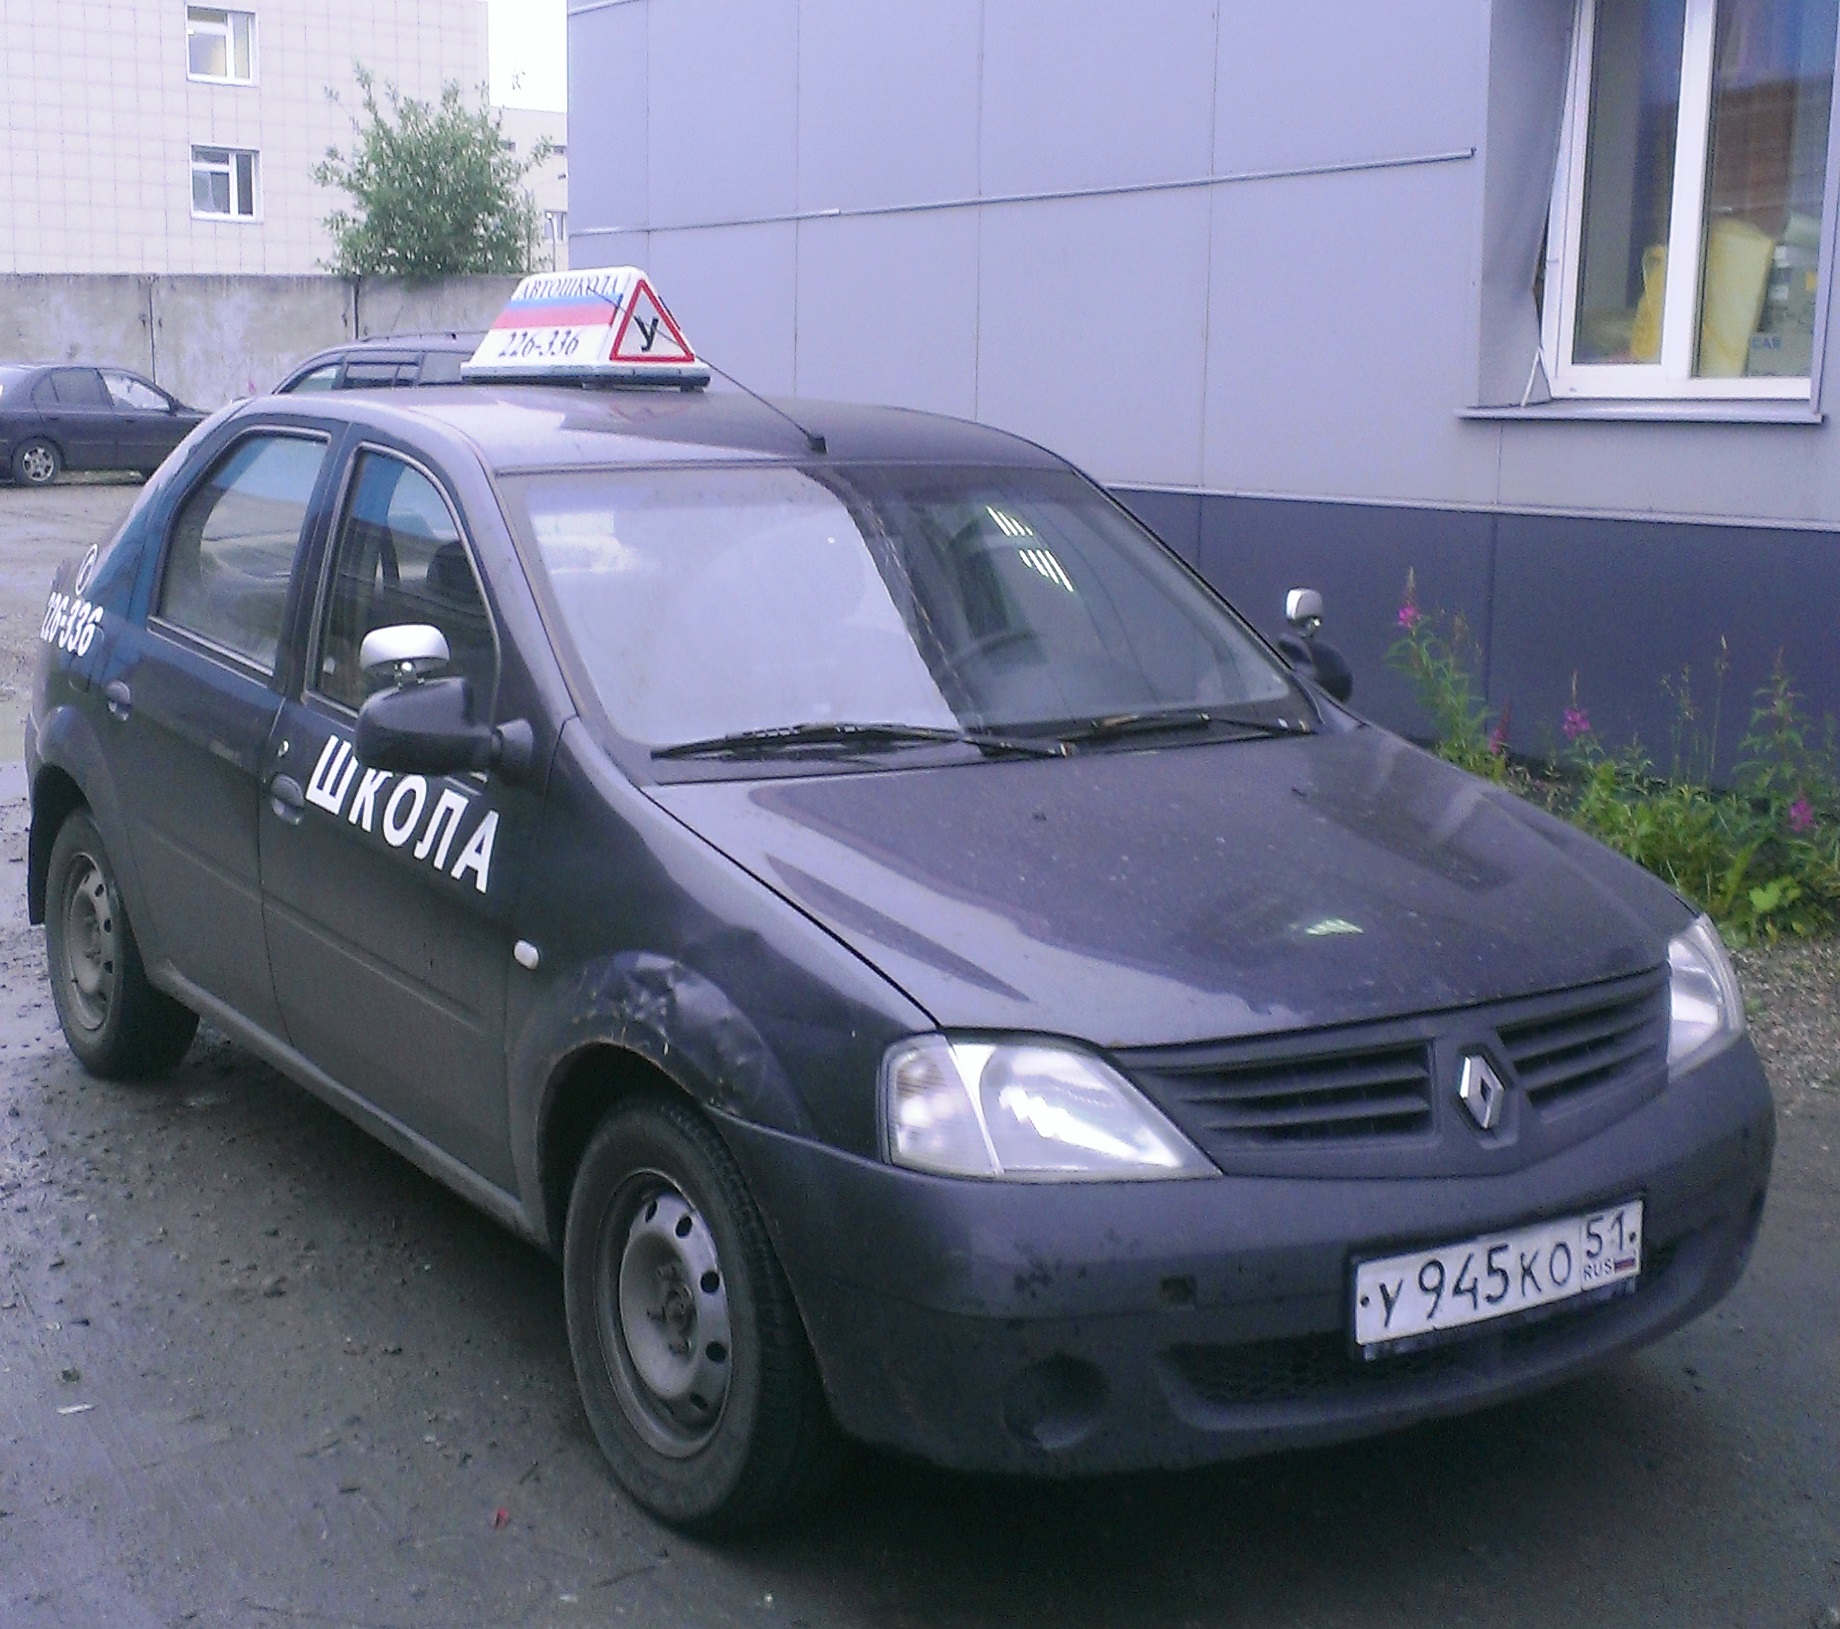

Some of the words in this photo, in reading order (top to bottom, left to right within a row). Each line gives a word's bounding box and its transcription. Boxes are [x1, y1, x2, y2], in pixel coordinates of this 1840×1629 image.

[521, 276, 618, 299] АВТОШКОЛА
[498, 330, 581, 357] 226-336
[634, 317, 659, 353] У
[305, 734, 500, 894] ШКОЛА
[1583, 1258, 1614, 1281] RUS
